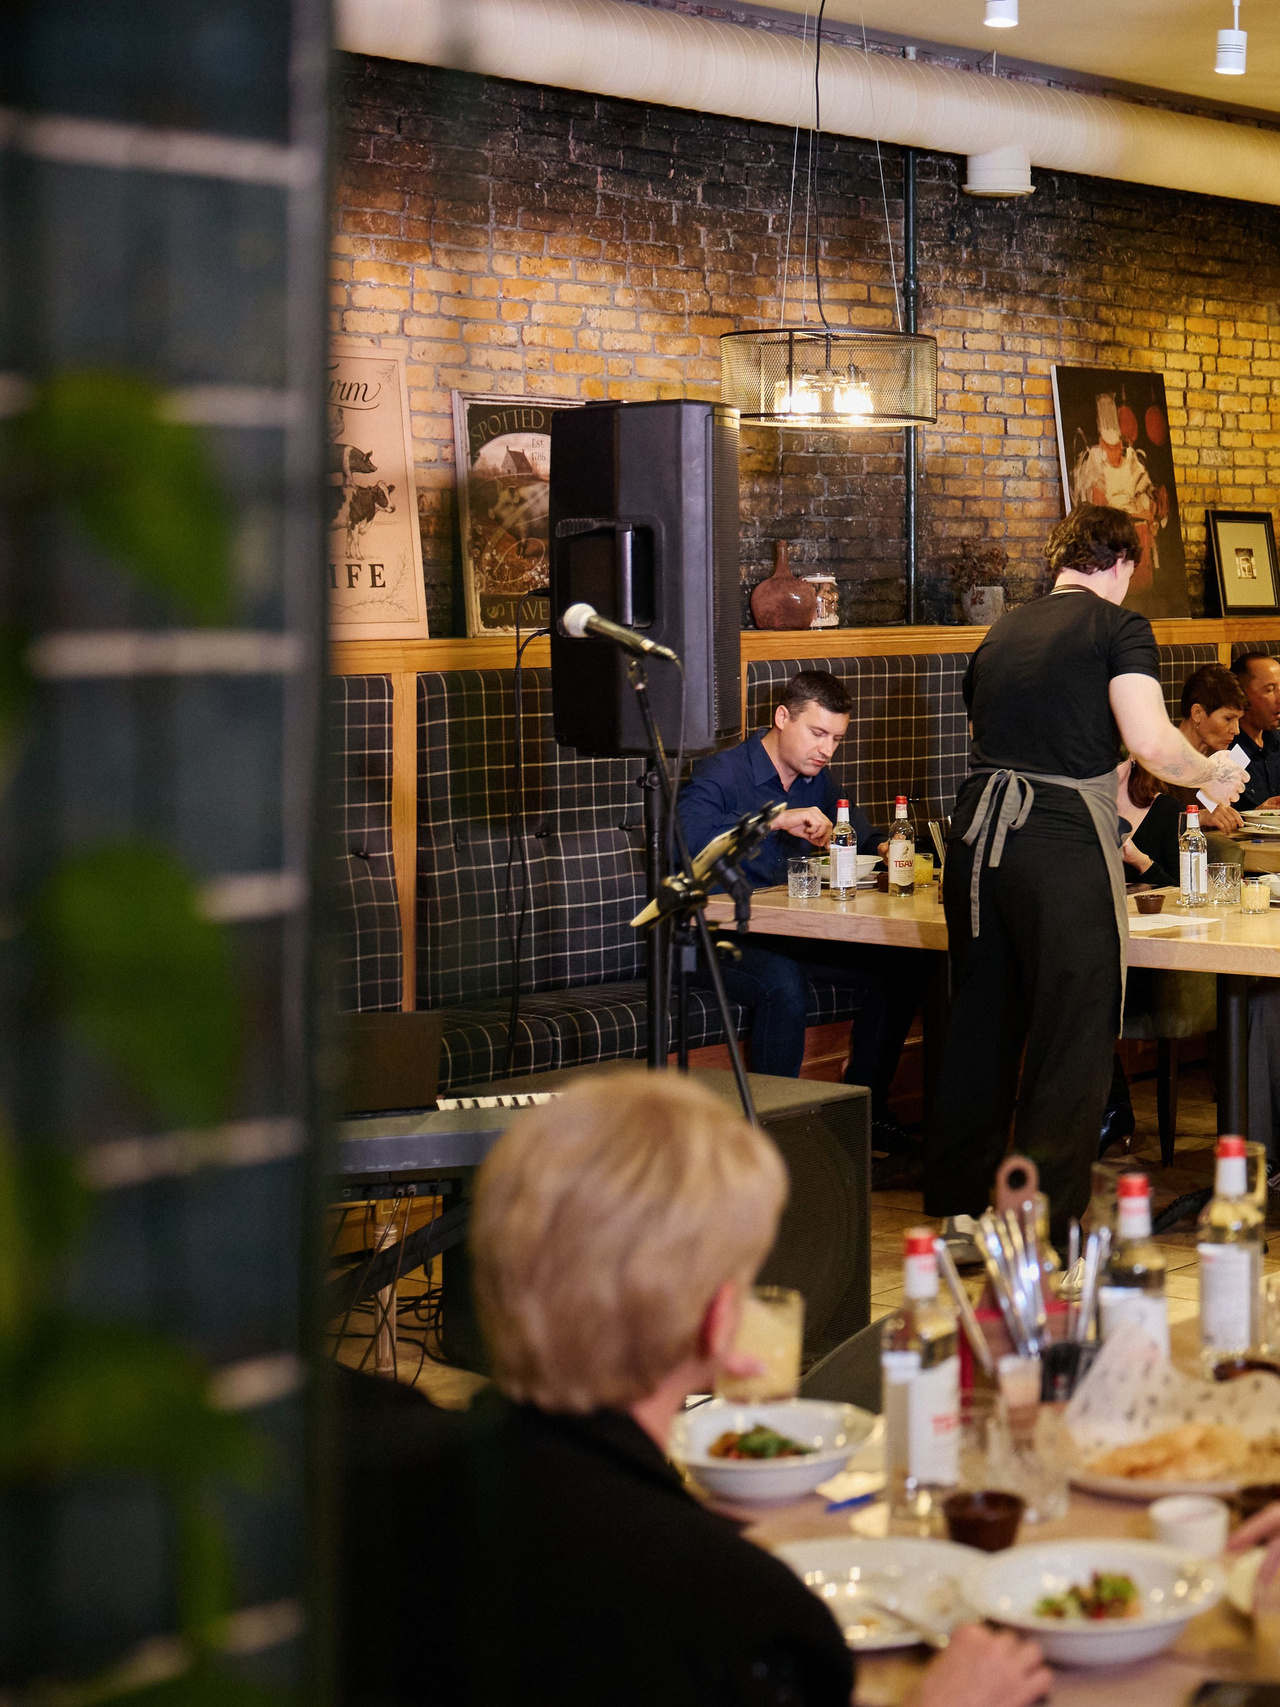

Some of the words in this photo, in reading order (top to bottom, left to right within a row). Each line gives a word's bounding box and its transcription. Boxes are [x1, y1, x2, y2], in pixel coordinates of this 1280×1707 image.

[471, 408, 544, 441] SPOTTED
[531, 439, 543, 448] Est
[328, 564, 386, 589] IFE
[507, 600, 550, 620] TAVE
